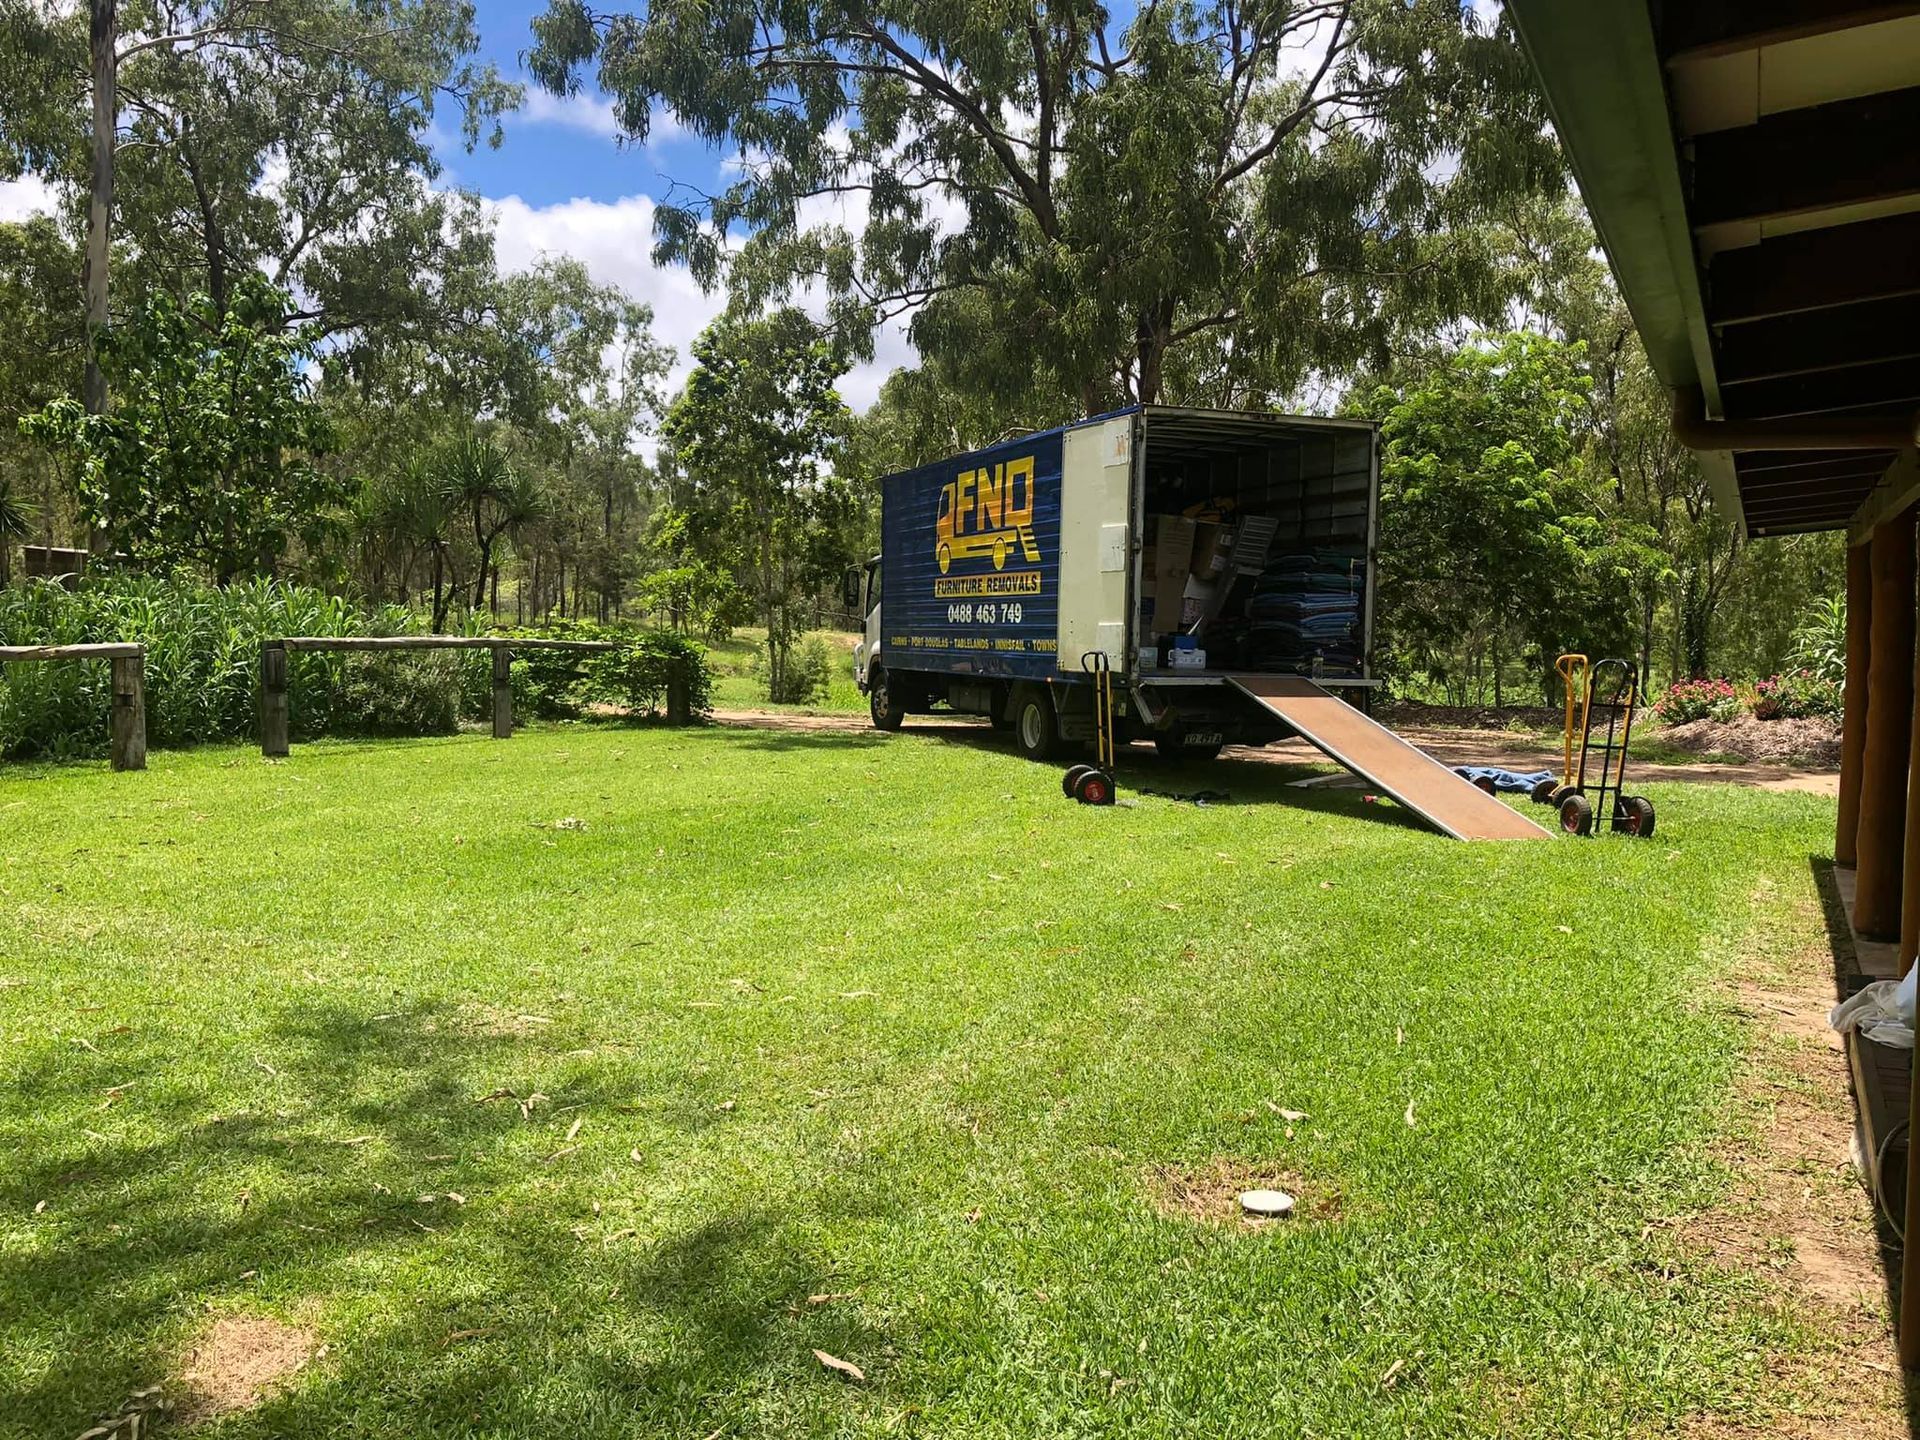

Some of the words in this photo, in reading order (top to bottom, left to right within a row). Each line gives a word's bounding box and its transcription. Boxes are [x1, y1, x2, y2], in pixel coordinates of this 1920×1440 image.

[936, 577, 983, 596] FURNITURE
[986, 573, 1037, 594] REMOVALS
[948, 604, 972, 624] 0488
[976, 604, 996, 624] 463
[1001, 603, 1022, 624] 749
[954, 638, 989, 650] TABLELANDS
